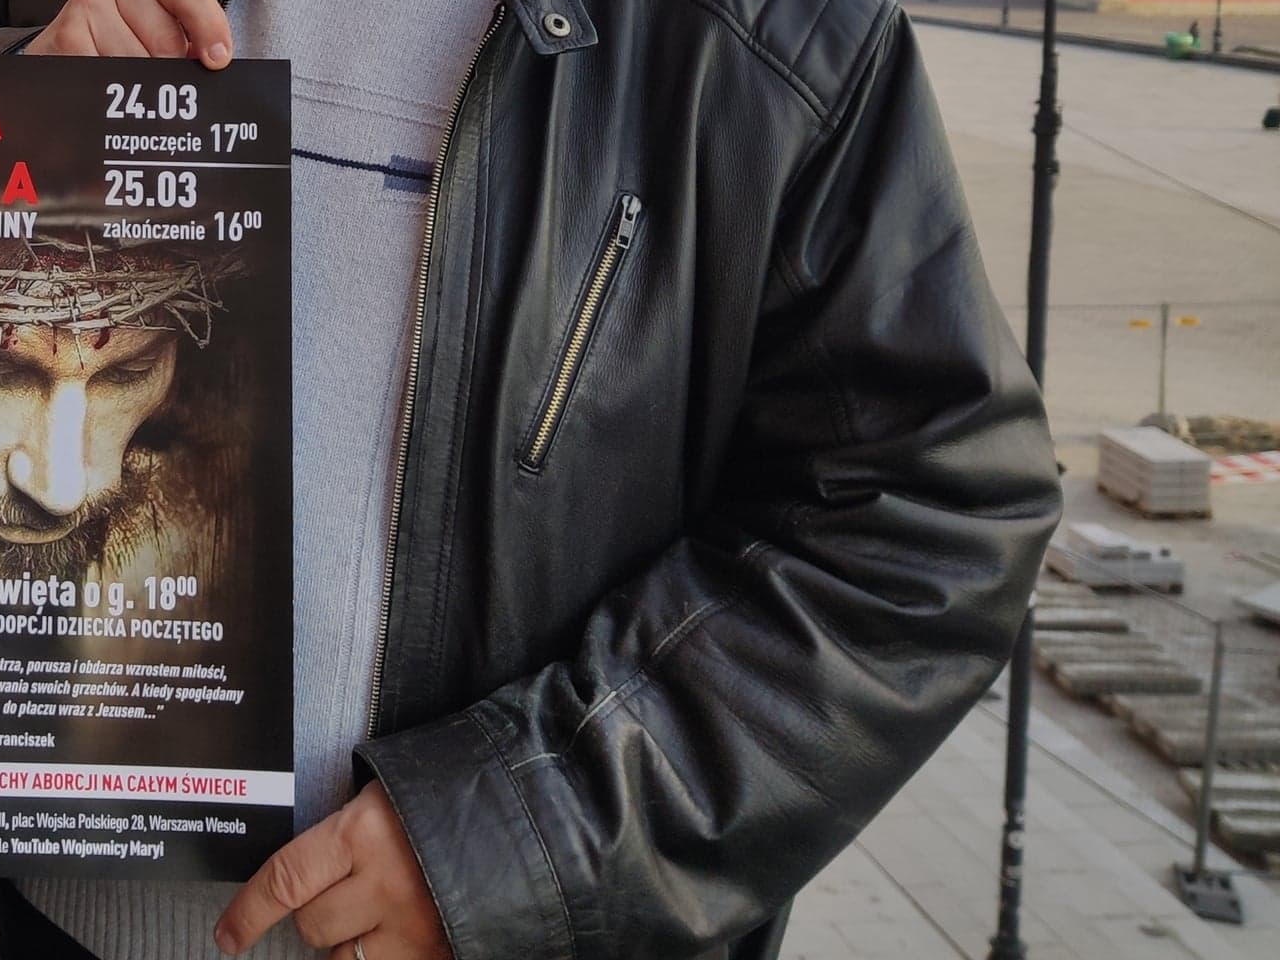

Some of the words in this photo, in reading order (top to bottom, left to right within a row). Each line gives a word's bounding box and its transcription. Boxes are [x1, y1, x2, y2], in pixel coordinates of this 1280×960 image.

[105, 83, 198, 120] 24.03
[104, 132, 202, 156] rozpoczęcie
[104, 169, 197, 208] 25.03
[102, 218, 206, 241] zakończenie
[83, 581, 100, 608] o
[108, 582, 135, 616] g.
[57, 616, 127, 637] DZIECKA
[130, 619, 224, 644] POCZĘTEGO
[26, 659, 71, 676] porusza
[73, 659, 79, 674] i
[79, 660, 124, 676] obdarza
[125, 662, 181, 678] wzrostem
[182, 664, 227, 681] miłości,
[30, 679, 70, 695] swoich
[72, 681, 130, 698] grzechów.
[131, 682, 141, 697] A
[142, 683, 173, 701] kiedy
[175, 686, 244, 704] spoglądamy
[2, 700, 17, 715] do
[18, 701, 56, 718] płaczu
[58, 704, 87, 718] wraz
[87, 706, 94, 718] z
[32, 773, 99, 792] ABORCJI
[102, 774, 124, 792] NA
[127, 774, 178, 794] CAŁYM
[182, 773, 247, 797] ŚWIECIE
[11, 813, 34, 831] plac
[36, 812, 76, 832] Wojska
[78, 813, 129, 833] Polskiego
[131, 815, 147, 832] 28,
[149, 815, 204, 833] Warszawa
[205, 816, 247, 835] Wesoła
[11, 837, 60, 855] YouTube
[61, 838, 128, 859] Wojownicy
[129, 840, 165, 859] Maryi
